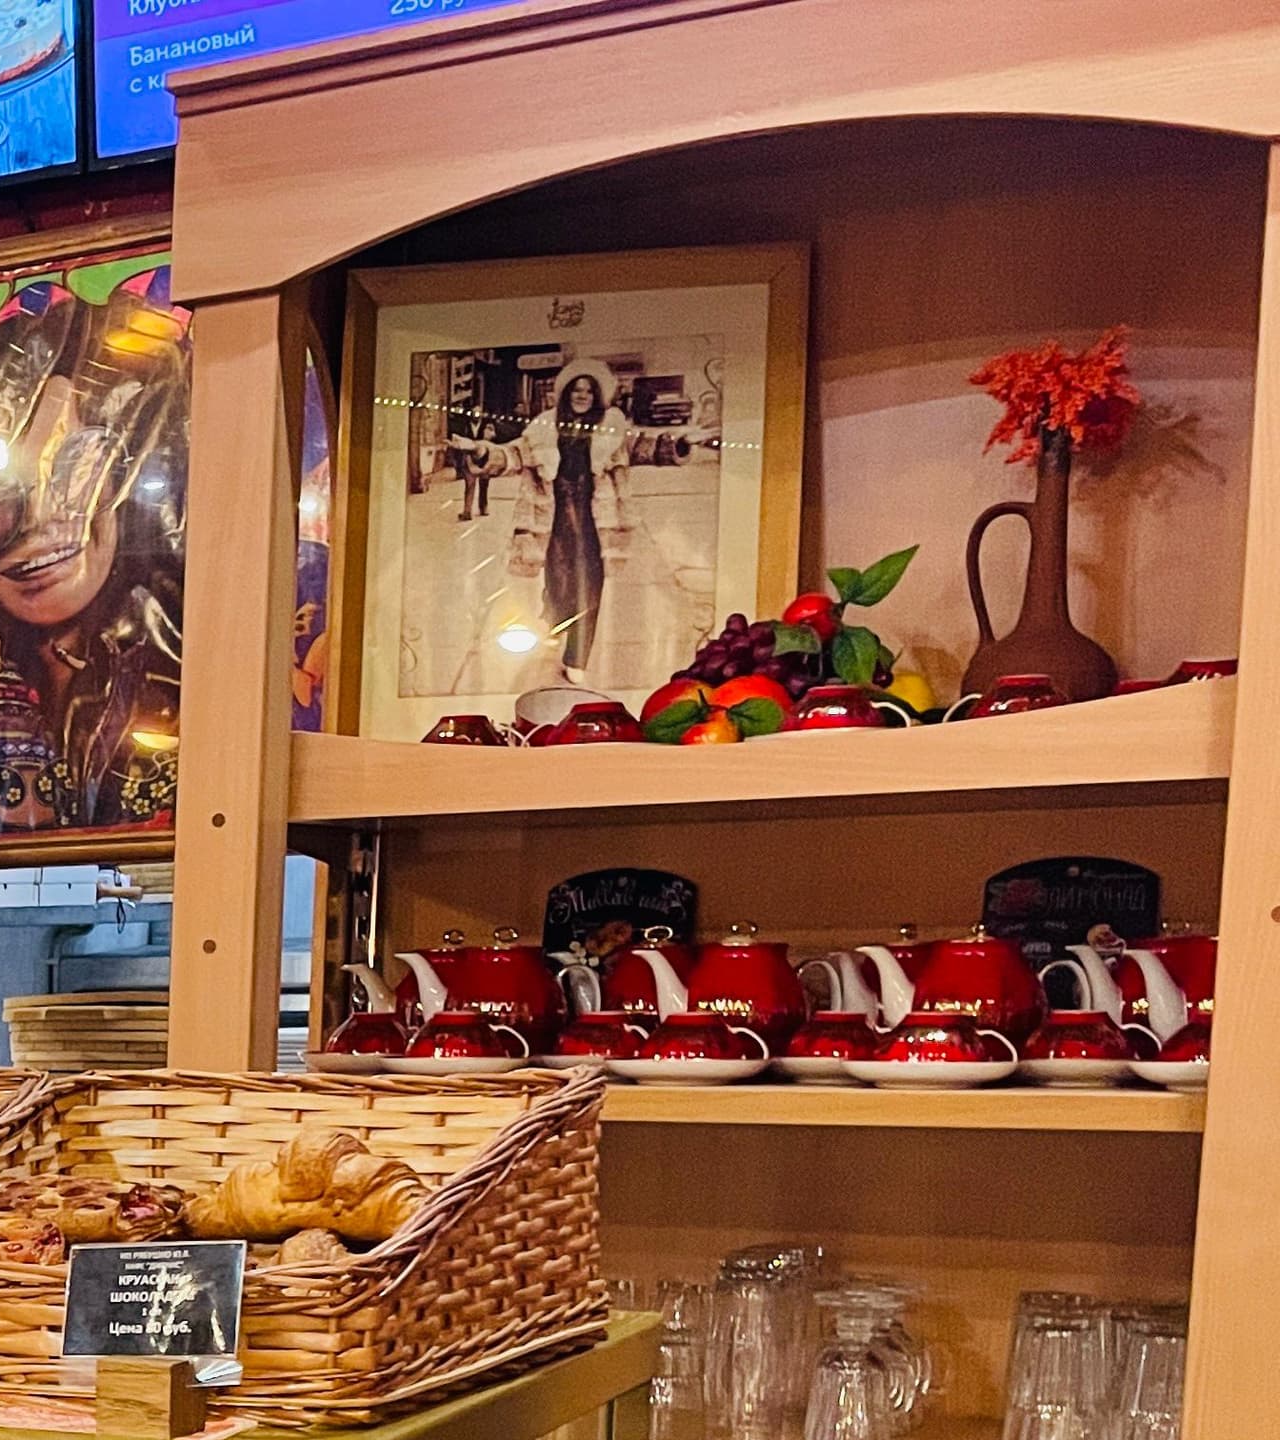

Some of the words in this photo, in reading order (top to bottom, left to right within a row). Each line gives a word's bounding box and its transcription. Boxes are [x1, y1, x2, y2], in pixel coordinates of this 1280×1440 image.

[129, 23, 255, 66] Банановый
[129, 78, 142, 93] с
[109, 1322, 143, 1336] Цена
